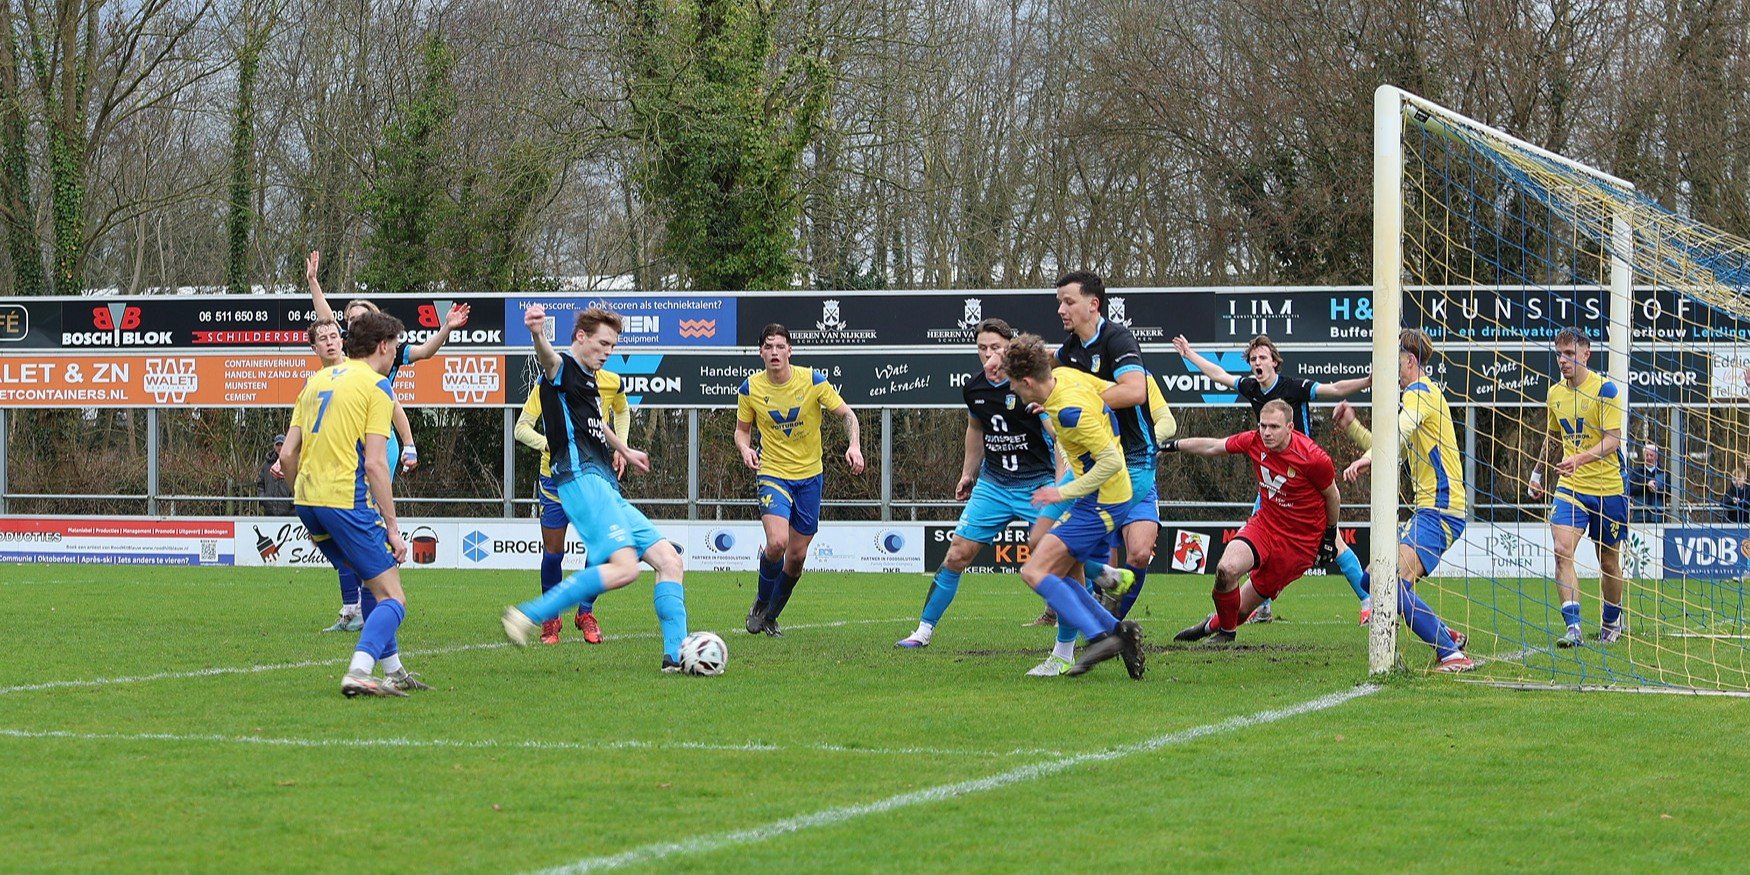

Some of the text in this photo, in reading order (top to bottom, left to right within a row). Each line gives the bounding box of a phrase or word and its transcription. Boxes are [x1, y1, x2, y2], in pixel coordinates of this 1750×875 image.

[588, 300, 607, 310] Ook
[610, 302, 638, 310] scoren
[640, 300, 652, 310] als
[654, 300, 722, 310] techniektalent?
[1331, 297, 1373, 320] H&
[199, 311, 268, 322] 06 511 650 83
[288, 310, 301, 321] 06
[304, 310, 318, 321] 46
[208, 332, 309, 342] SCHILDERSBE
[397, 330, 502, 343] OSCH BLOK
[821, 331, 839, 339] VAN
[840, 331, 877, 339] NIJKERK
[927, 330, 975, 339] HEEREN VA
[1330, 326, 1373, 338] Buffer
[62, 332, 173, 345] BOSCH BLOK
[618, 335, 659, 344] Equipment
[225, 359, 306, 368] CONTAINERVERHUUR
[0, 363, 129, 384] LET & ZN
[225, 371, 260, 379] HANDEL
[261, 371, 267, 379] IN
[268, 371, 290, 379] ZAND
[292, 371, 299, 379] &
[875, 363, 909, 380] Watt
[146, 376, 196, 385] WALET
[445, 375, 498, 385] WALET
[1162, 375, 1229, 391] VOIT
[1629, 371, 1697, 386] PONSOR
[625, 377, 682, 392] URON
[869, 375, 930, 397] een kracht!
[225, 393, 256, 401] CEMENT
[38, 555, 76, 563] Oktoberfest
[81, 555, 113, 564] Après-ski
[132, 556, 155, 564] anders
[165, 557, 189, 565] vieren?
